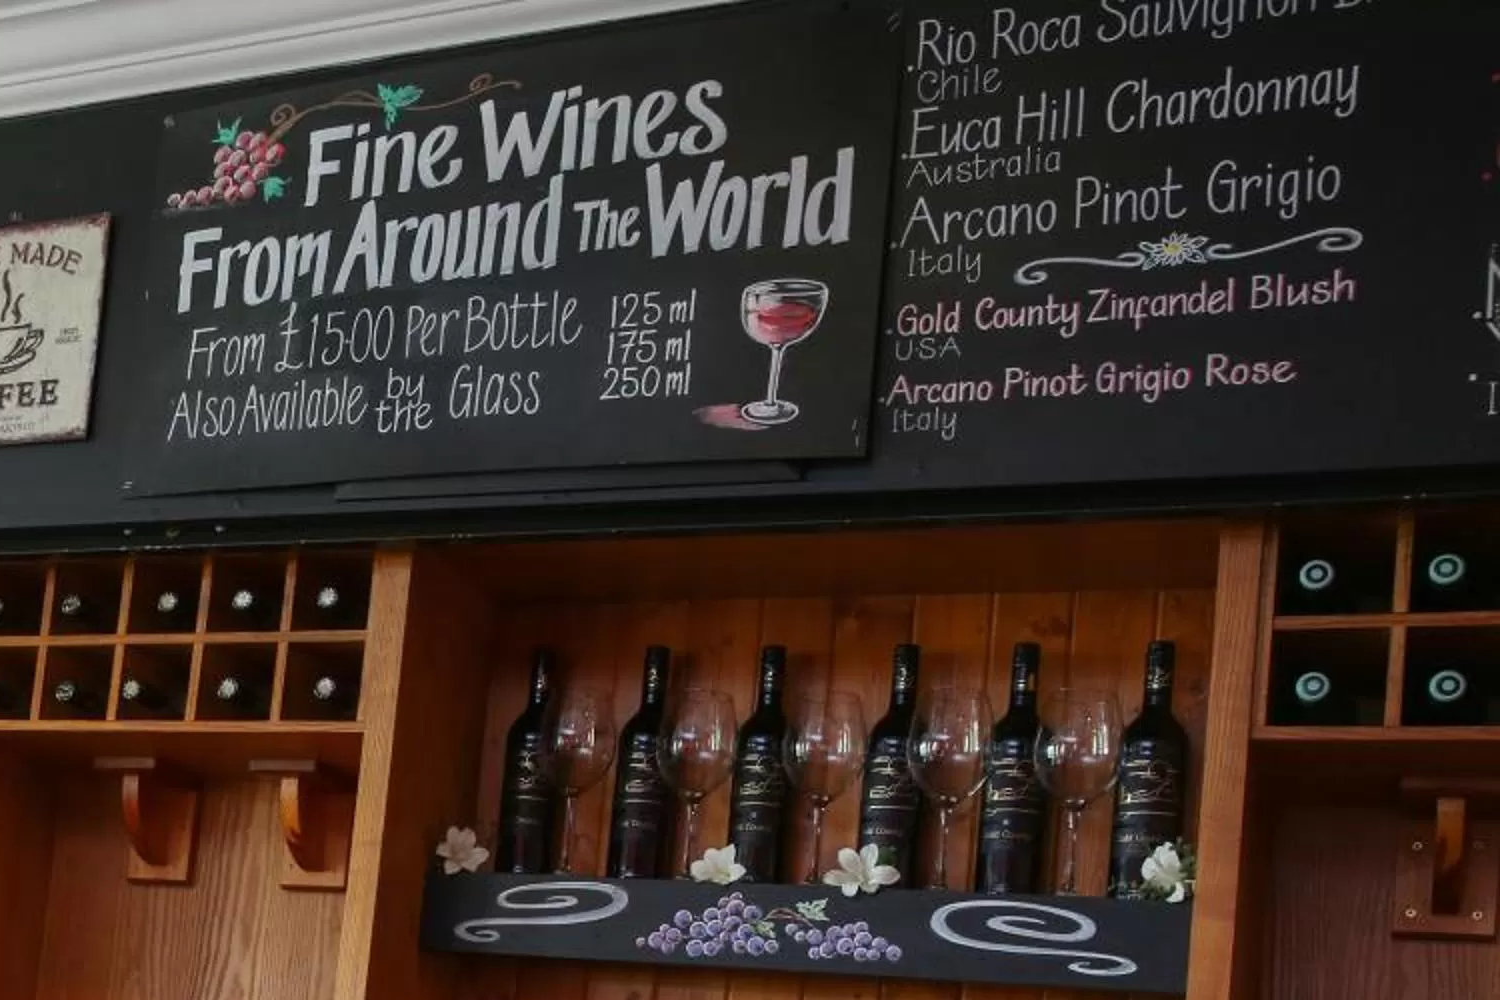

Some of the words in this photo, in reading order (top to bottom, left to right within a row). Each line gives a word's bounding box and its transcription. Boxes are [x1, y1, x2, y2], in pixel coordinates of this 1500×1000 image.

[916, 18, 978, 70] Rio
[991, 7, 1082, 60] Roca
[916, 62, 1002, 103] Chile
[909, 105, 1002, 159] Euca
[1015, 86, 1086, 145] Hill
[1106, 65, 1360, 133] Chardonnay
[303, 121, 464, 207] Fine
[478, 78, 729, 184] Wines
[905, 144, 1062, 189] Australia
[899, 196, 1058, 249] Arcano
[1073, 166, 1187, 230] Pinot
[1206, 155, 1342, 221] Grigio
[176, 225, 335, 314] From
[331, 170, 564, 296] Around
[572, 199, 642, 254] The
[643, 146, 856, 259] World
[10, 240, 84, 276] MADE
[907, 244, 983, 284] Italy
[610, 290, 662, 329] 125
[668, 287, 697, 325] ml
[896, 300, 962, 337] Gold
[974, 292, 1081, 339] County
[1085, 275, 1237, 332] Zinfandel
[1249, 268, 1358, 311] Blush
[186, 326, 266, 381] From
[404, 304, 460, 360] Per
[462, 289, 584, 355] Bottle
[606, 329, 657, 366] 175
[664, 327, 691, 362] ml
[237, 374, 369, 437] Available
[385, 367, 425, 408] by
[448, 362, 542, 420] Glass
[599, 365, 661, 401] 250
[664, 361, 691, 398] ml
[884, 373, 994, 408] Arcano
[1002, 362, 1089, 401] Pinot
[1094, 360, 1192, 404] Grigio
[1204, 352, 1299, 388] Rose
[166, 389, 235, 443] Also
[374, 395, 434, 434] the
[892, 406, 958, 442] Italy
